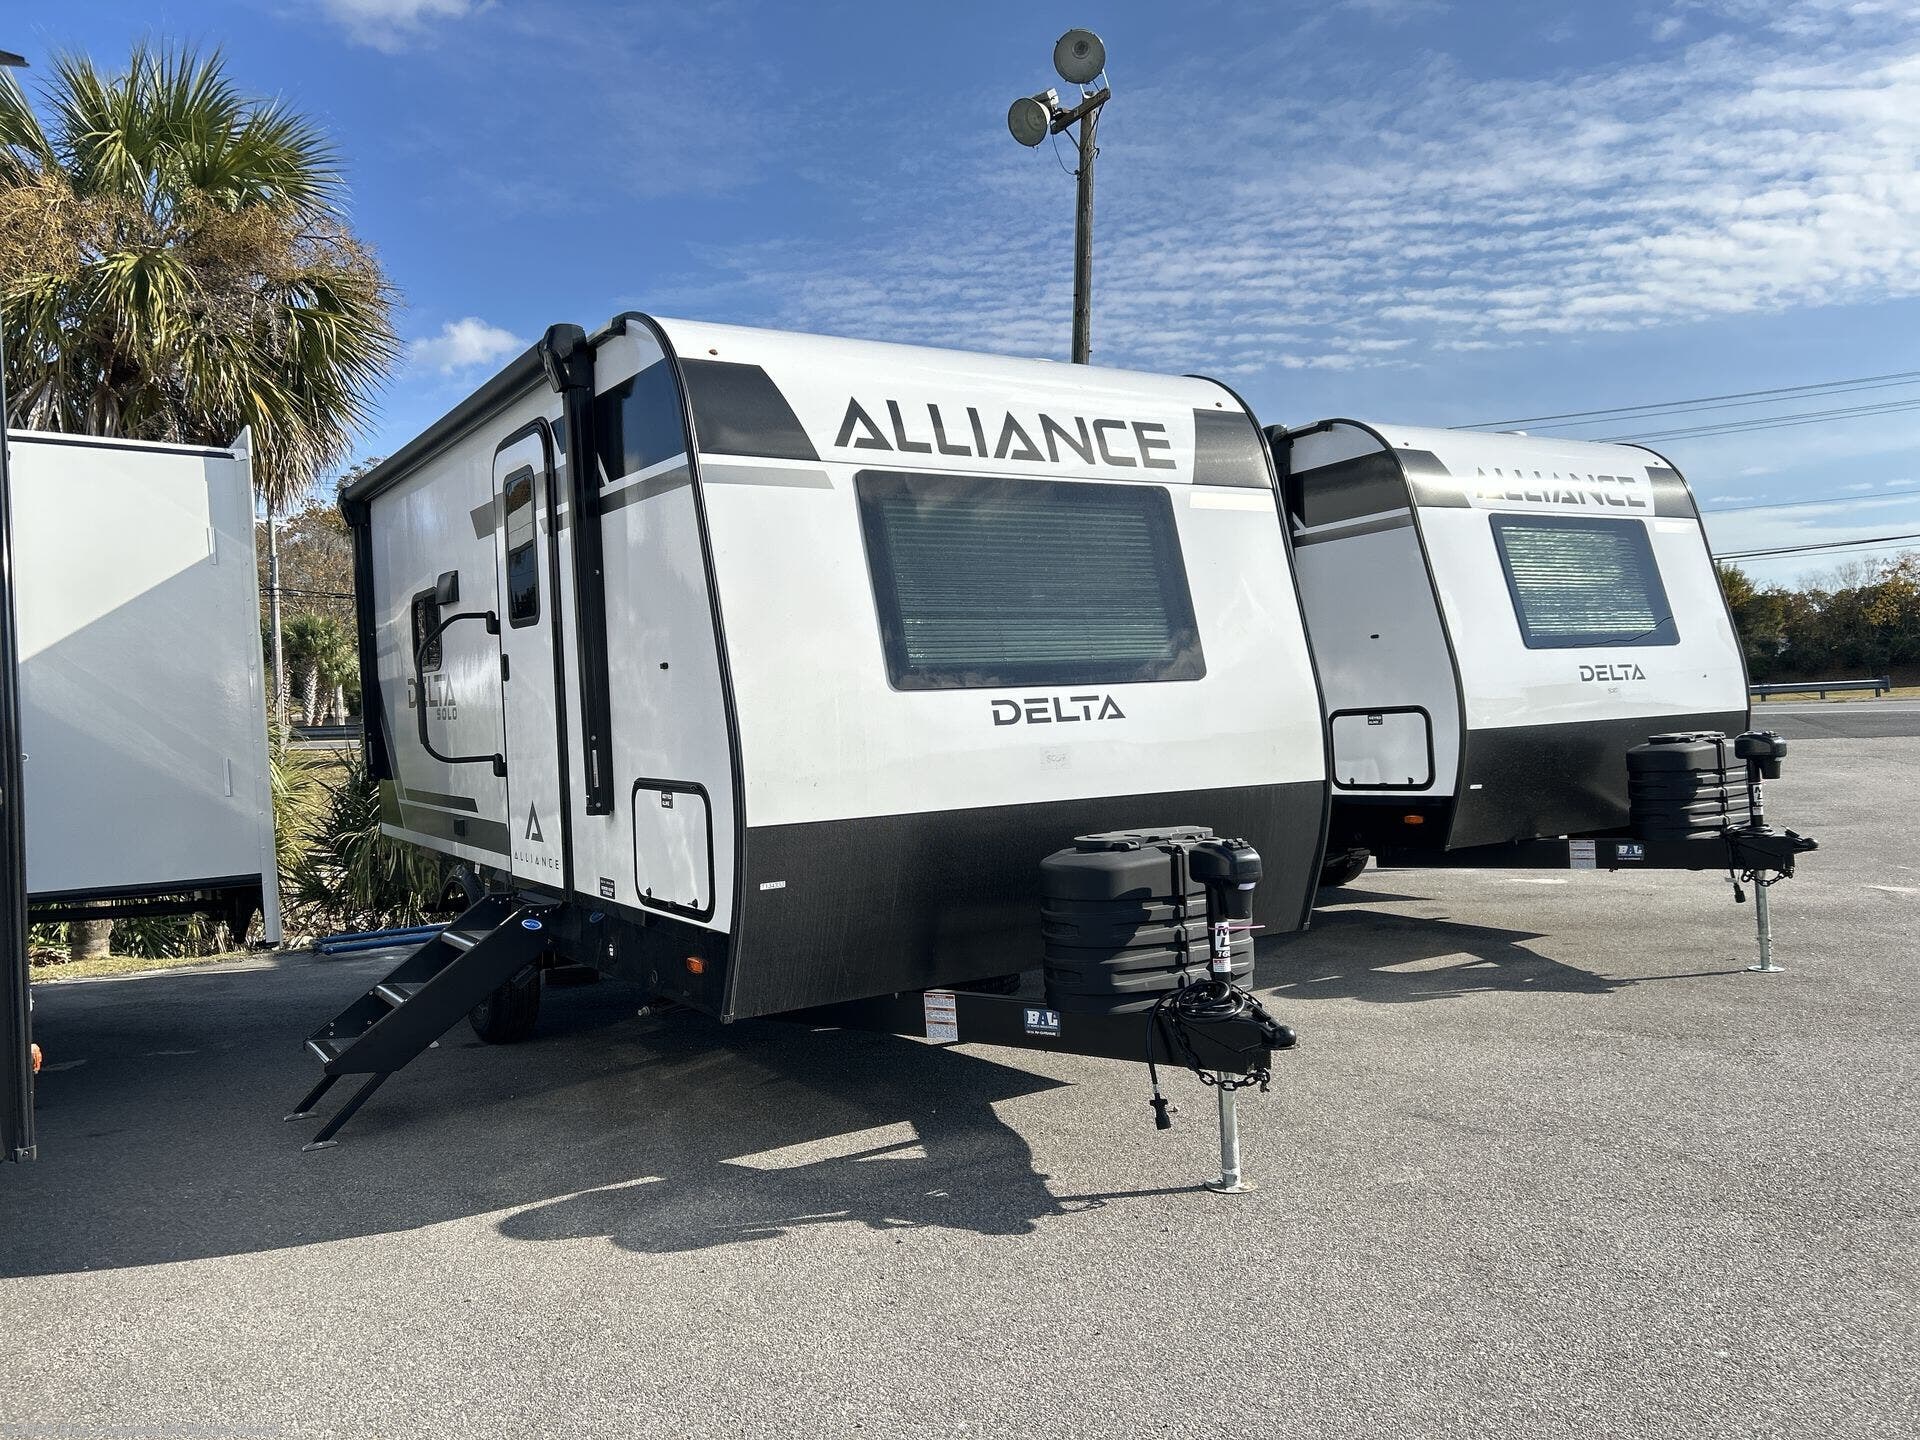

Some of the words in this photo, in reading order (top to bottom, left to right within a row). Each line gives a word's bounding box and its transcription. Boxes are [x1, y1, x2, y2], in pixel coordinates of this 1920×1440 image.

[834, 396, 1177, 470] ALLIANCE
[1476, 466, 1646, 508] ALLIANCE
[1579, 664, 1646, 682] DELTA
[436, 707, 458, 721] SOLO
[991, 694, 1126, 726] DELTA
[514, 851, 560, 870] ALLIANCE
